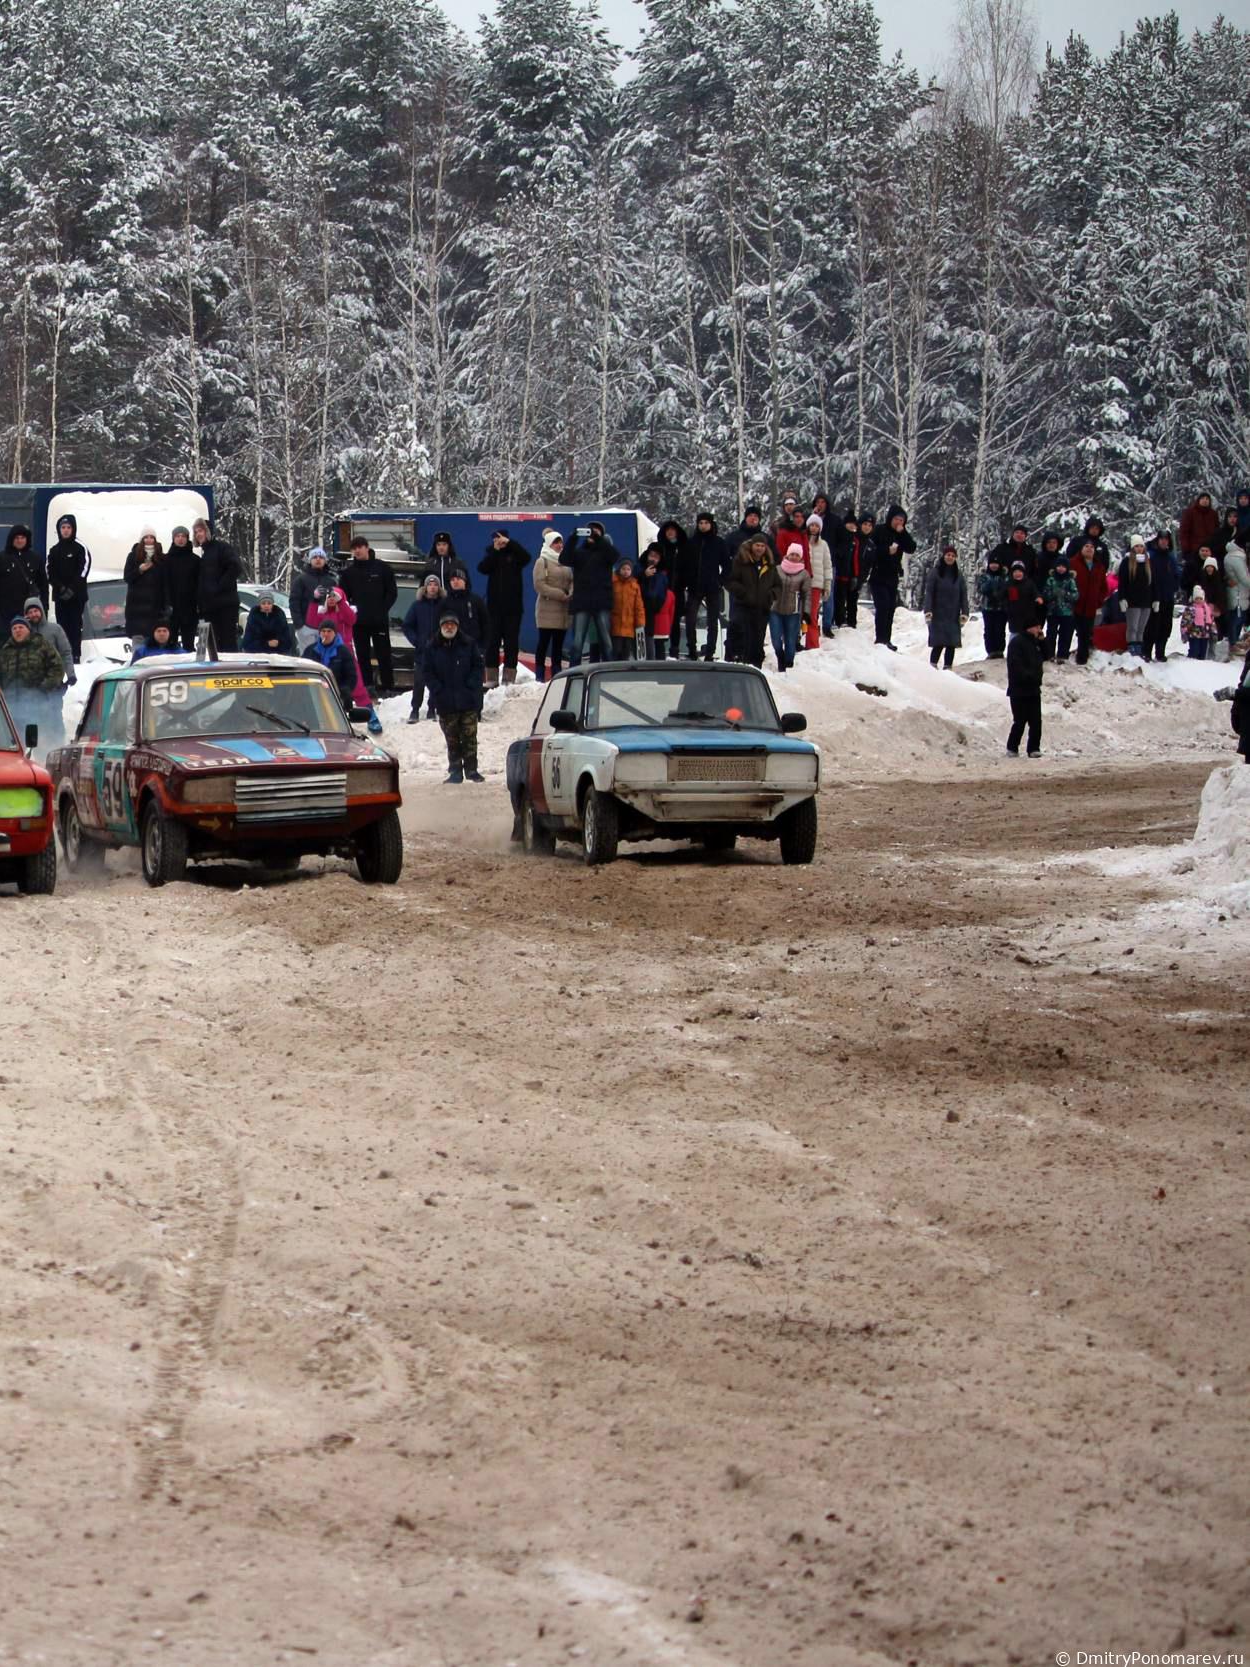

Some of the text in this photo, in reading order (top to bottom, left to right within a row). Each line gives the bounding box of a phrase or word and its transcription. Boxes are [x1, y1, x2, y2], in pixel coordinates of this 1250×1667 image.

[150, 681, 188, 707] 59
[213, 678, 264, 688] sparco
[552, 756, 560, 790] 56
[102, 762, 124, 819] 59
